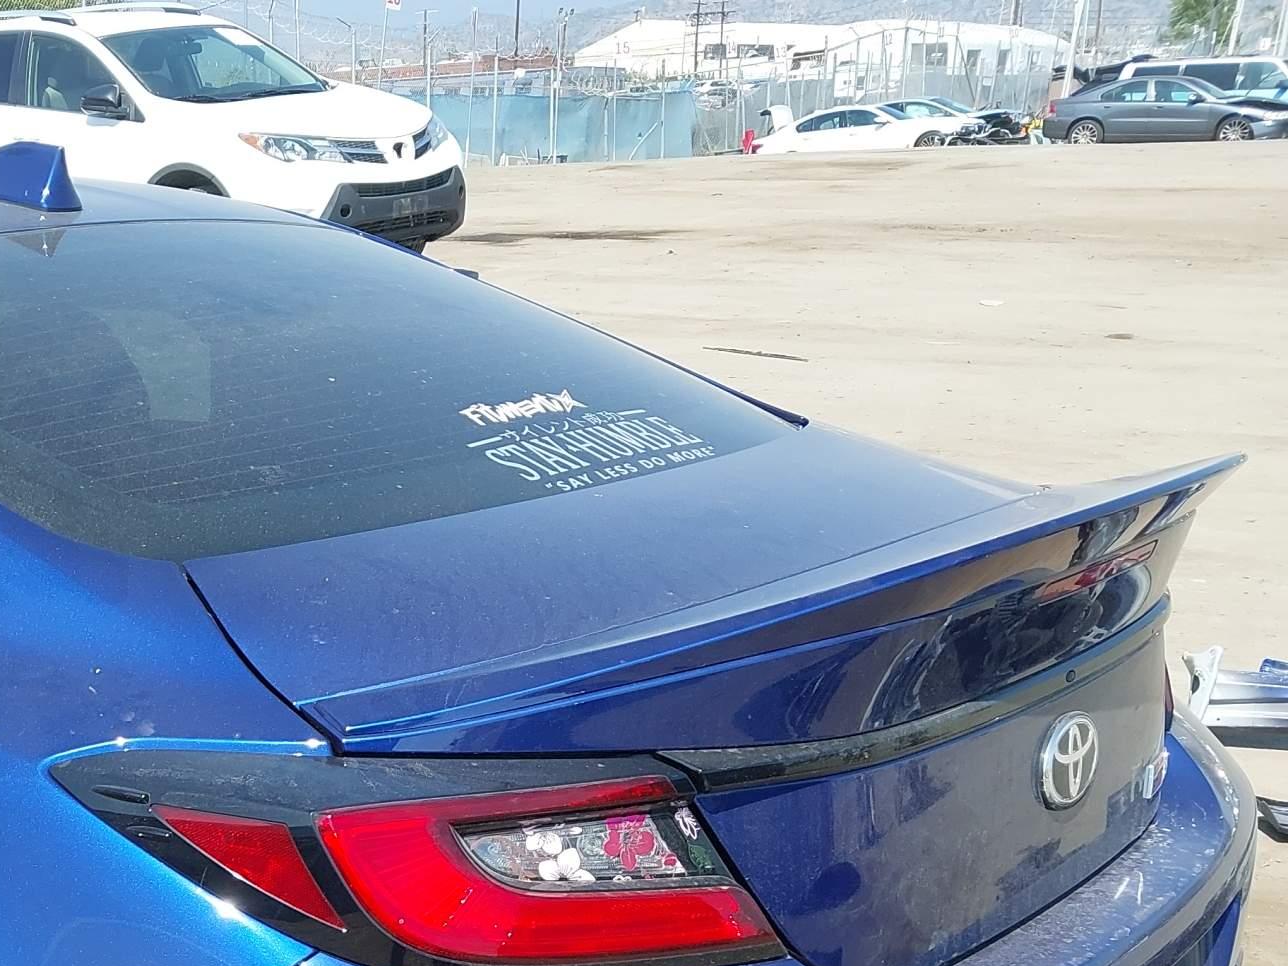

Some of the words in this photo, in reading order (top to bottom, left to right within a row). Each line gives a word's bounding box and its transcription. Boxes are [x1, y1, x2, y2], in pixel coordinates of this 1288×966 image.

[615, 41, 630, 54] 15
[485, 436, 592, 481] STAY
[559, 416, 704, 462] HUMBLE
[594, 462, 638, 480] LESS
[637, 455, 666, 470] DO
